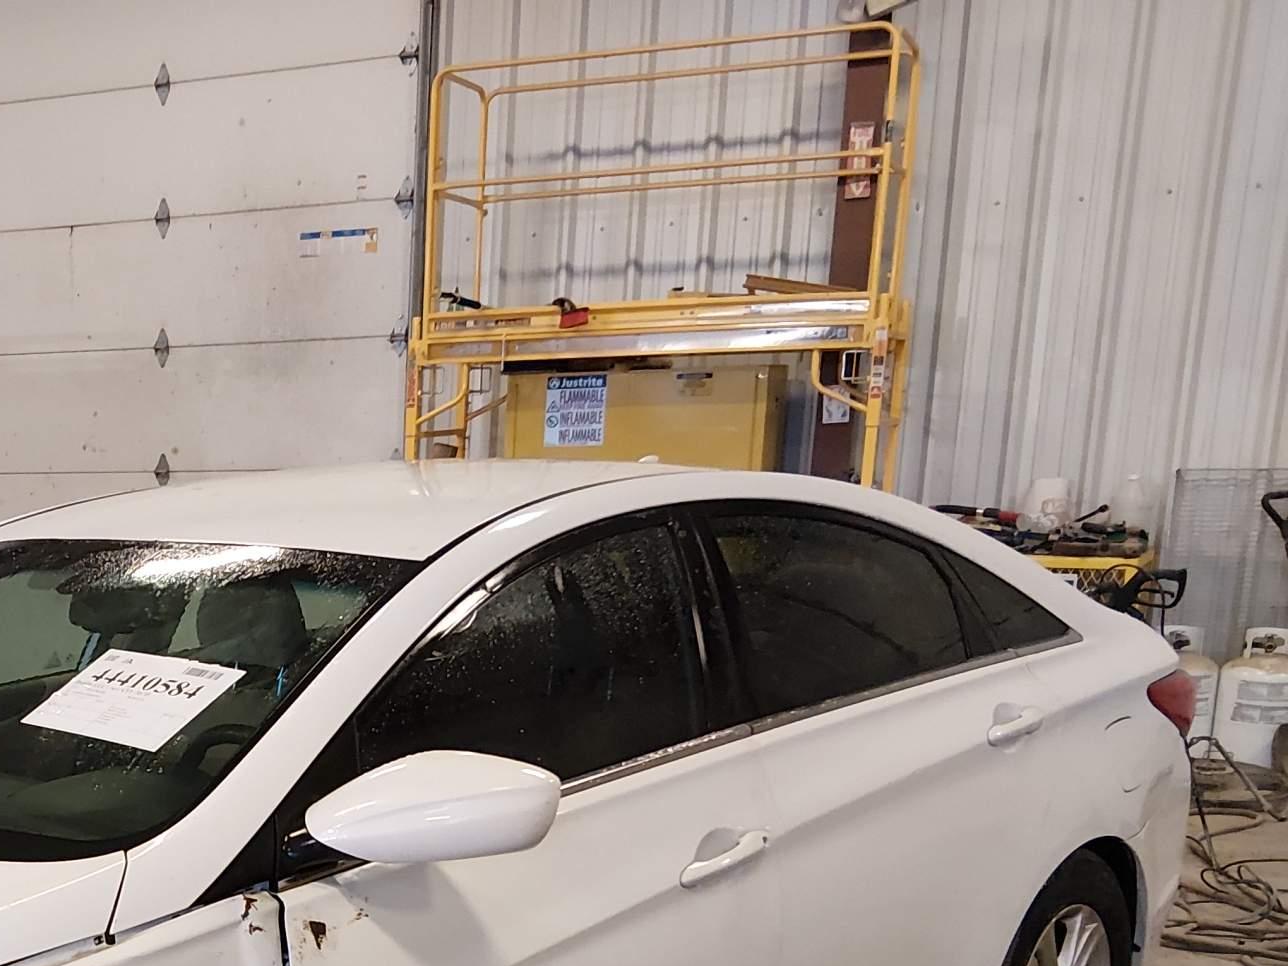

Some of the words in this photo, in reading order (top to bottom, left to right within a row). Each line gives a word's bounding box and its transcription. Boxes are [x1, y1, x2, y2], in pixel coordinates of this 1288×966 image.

[561, 376, 603, 388] Justrite
[559, 389, 604, 403] FLAMMABLE
[559, 411, 603, 425] INFLAMABLE
[558, 428, 601, 443] INFLAMMABLE
[91, 668, 206, 699] 44410584
